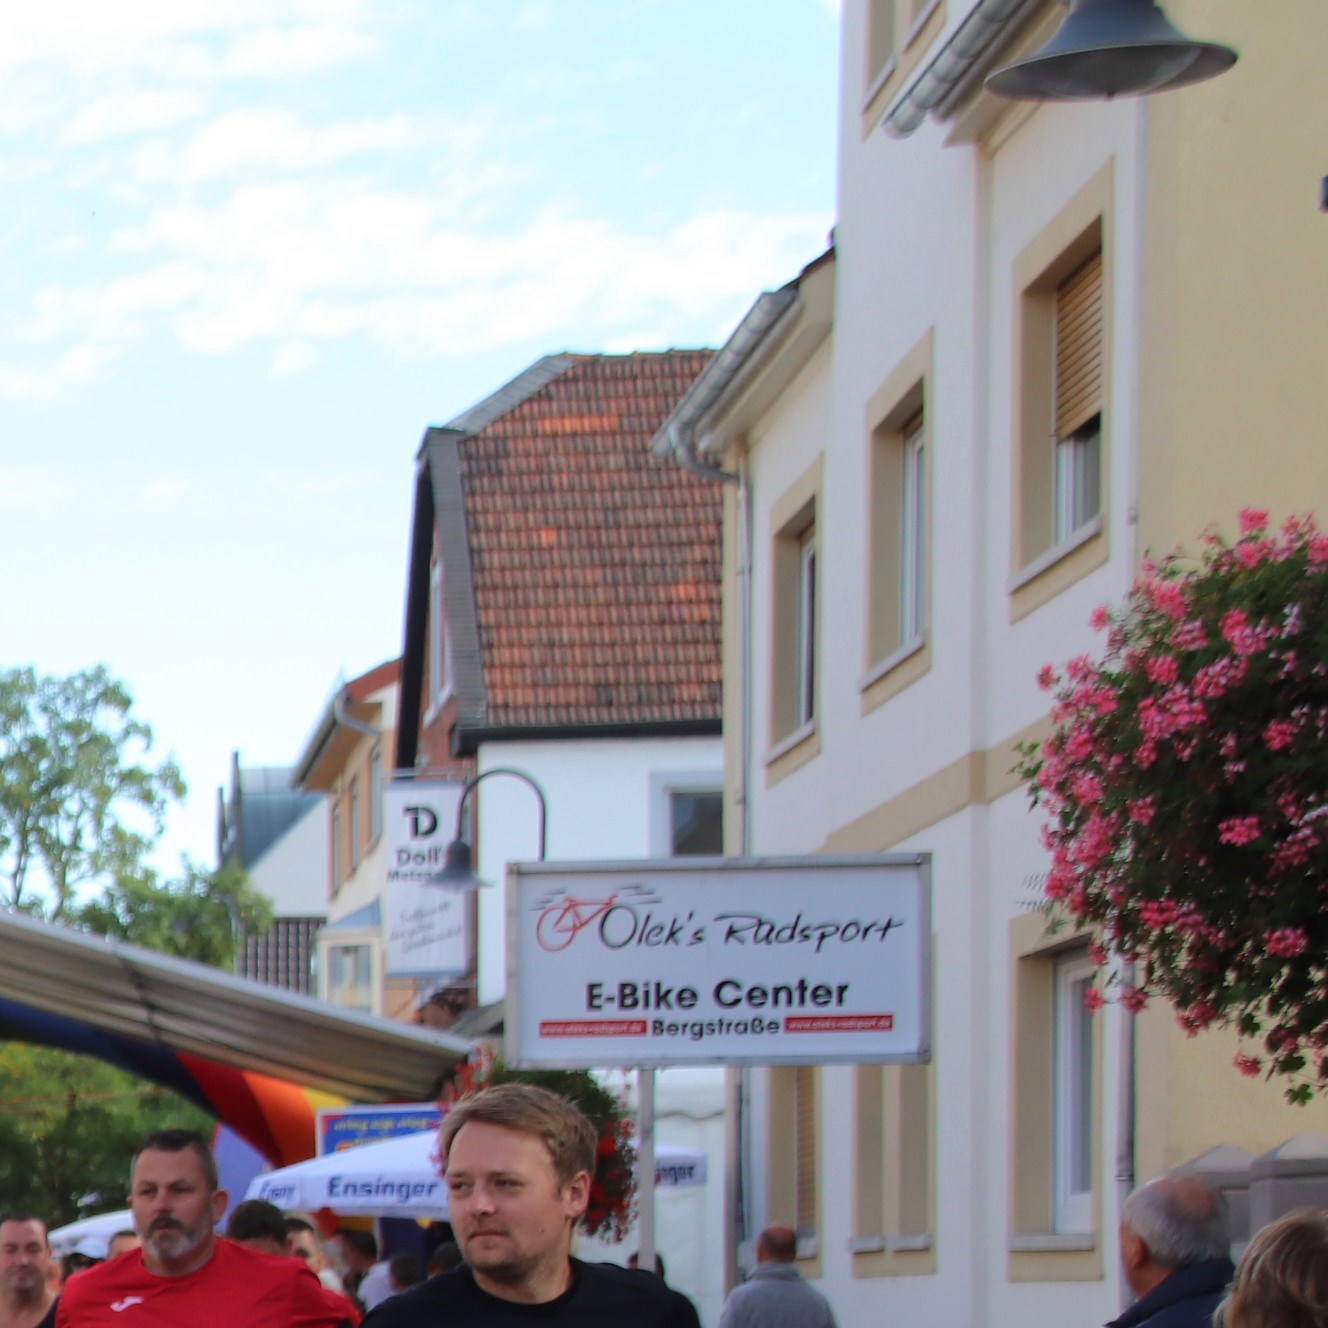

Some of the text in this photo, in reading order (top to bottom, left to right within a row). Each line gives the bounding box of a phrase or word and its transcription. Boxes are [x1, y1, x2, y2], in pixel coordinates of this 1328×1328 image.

[600, 905, 904, 953] Olek's Radsport
[586, 978, 849, 1011] E-Bike Center
[651, 1016, 780, 1041] Bergstraße
[327, 1175, 437, 1199] Ensinger
